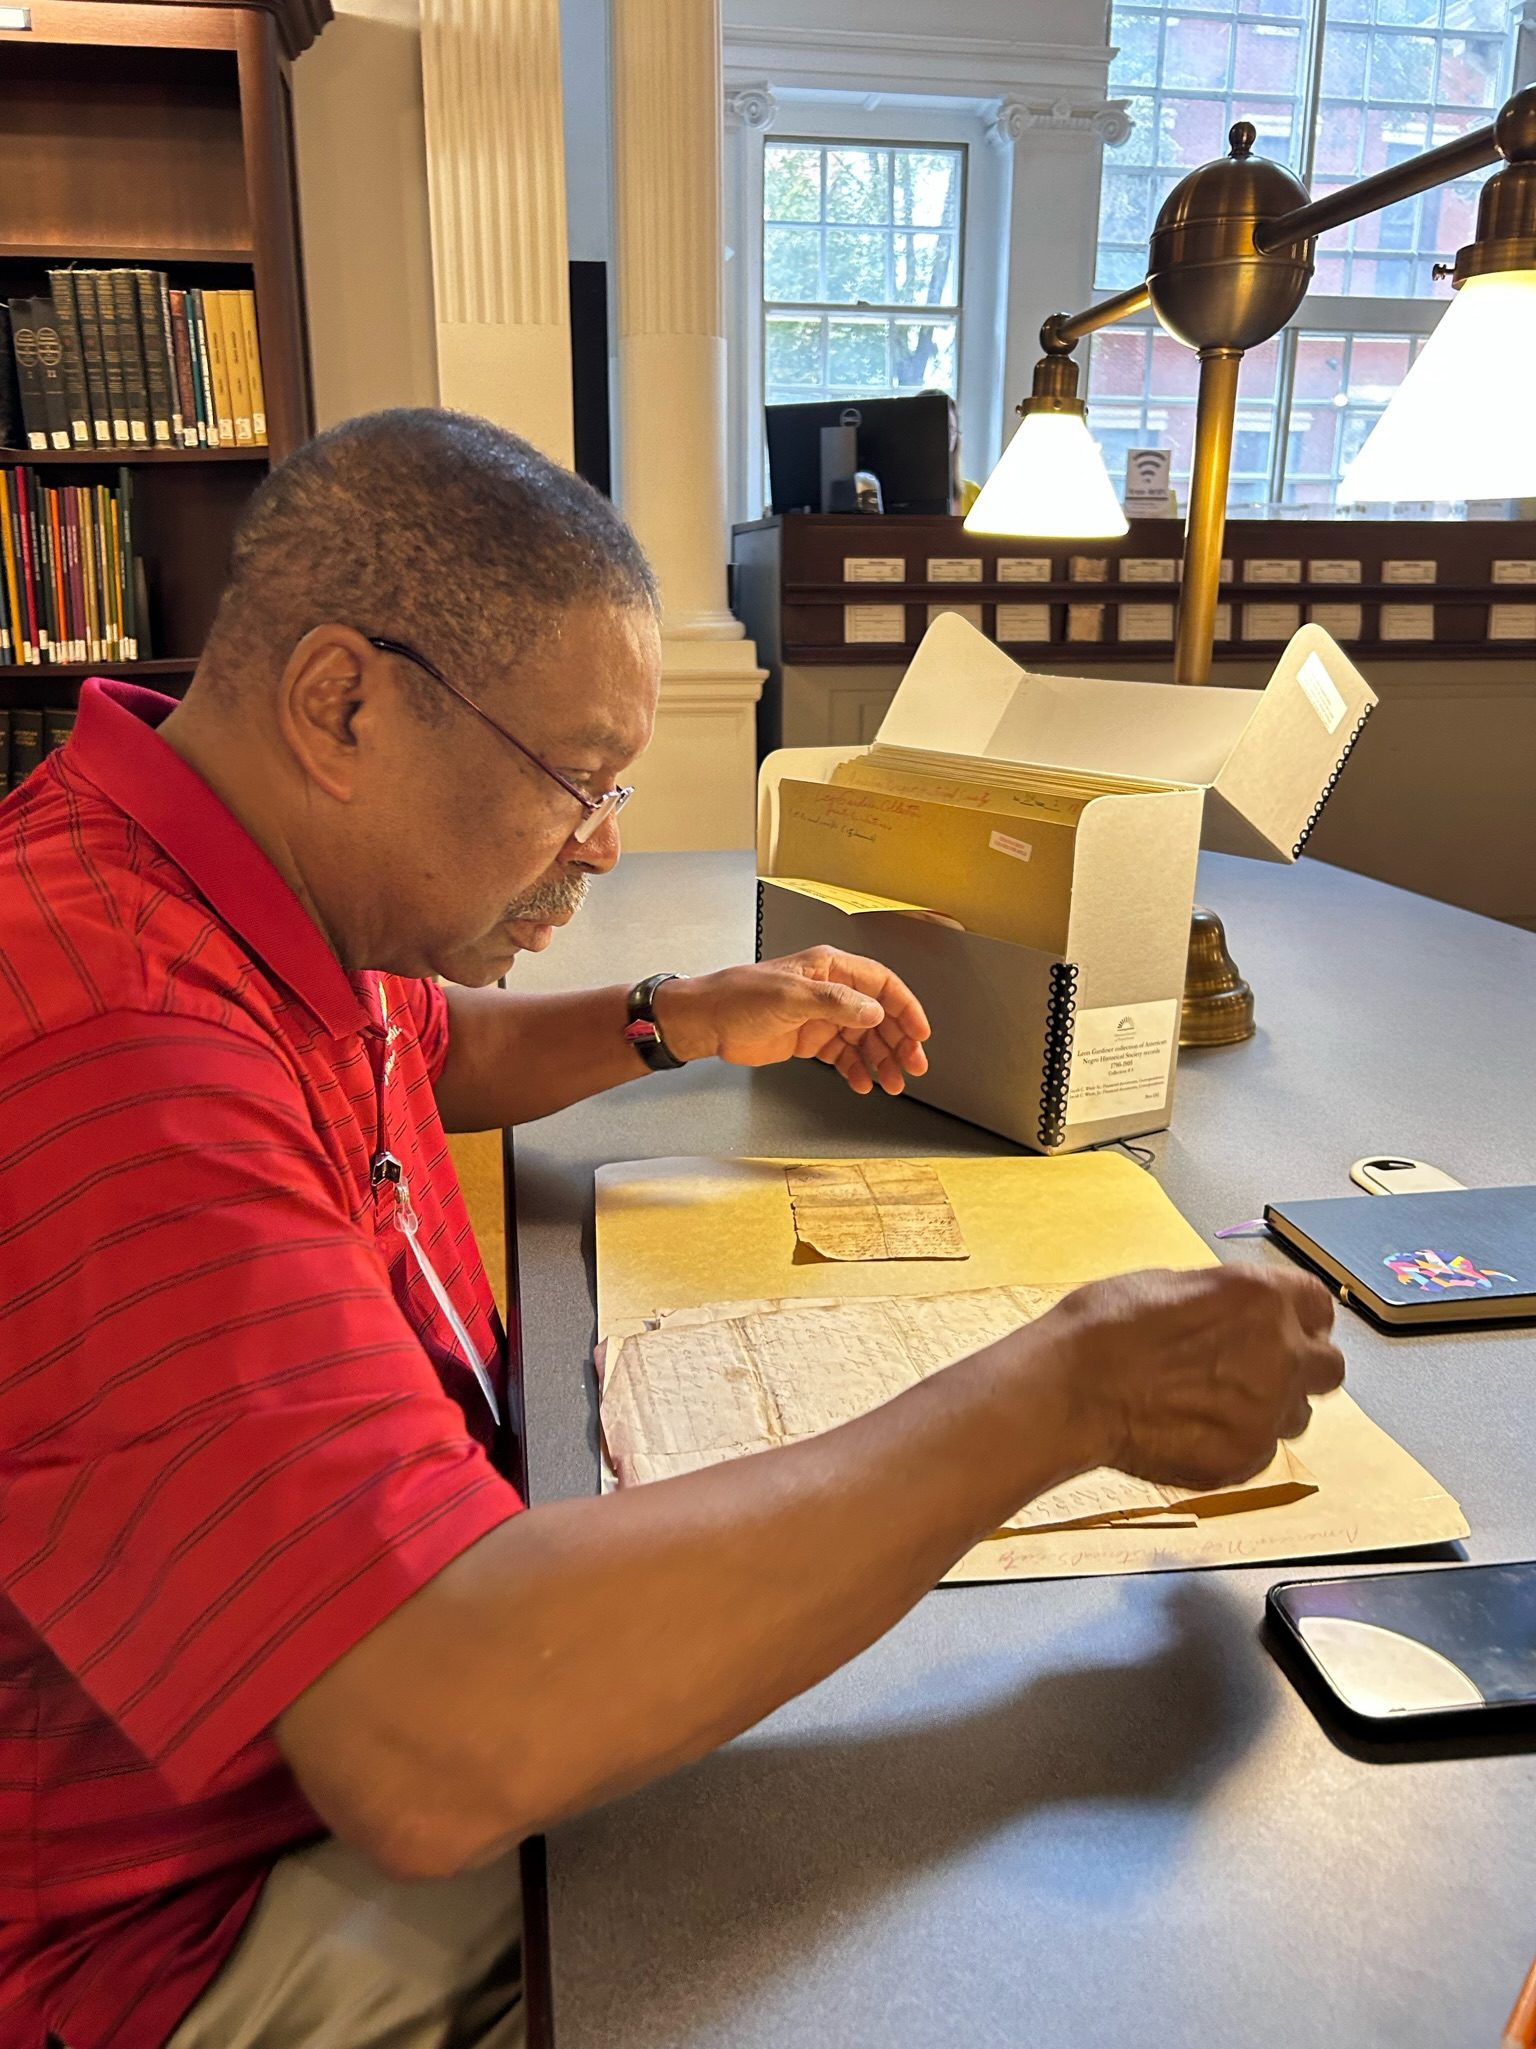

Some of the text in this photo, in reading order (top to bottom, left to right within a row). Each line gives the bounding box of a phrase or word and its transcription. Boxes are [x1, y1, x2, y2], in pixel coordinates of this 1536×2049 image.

[1091, 1047, 1114, 1055] Gardiner
[1114, 1044, 1138, 1052] collection
[1144, 1039, 1167, 1048] American
[1083, 1048, 1161, 1065] Negro Historical Society records
